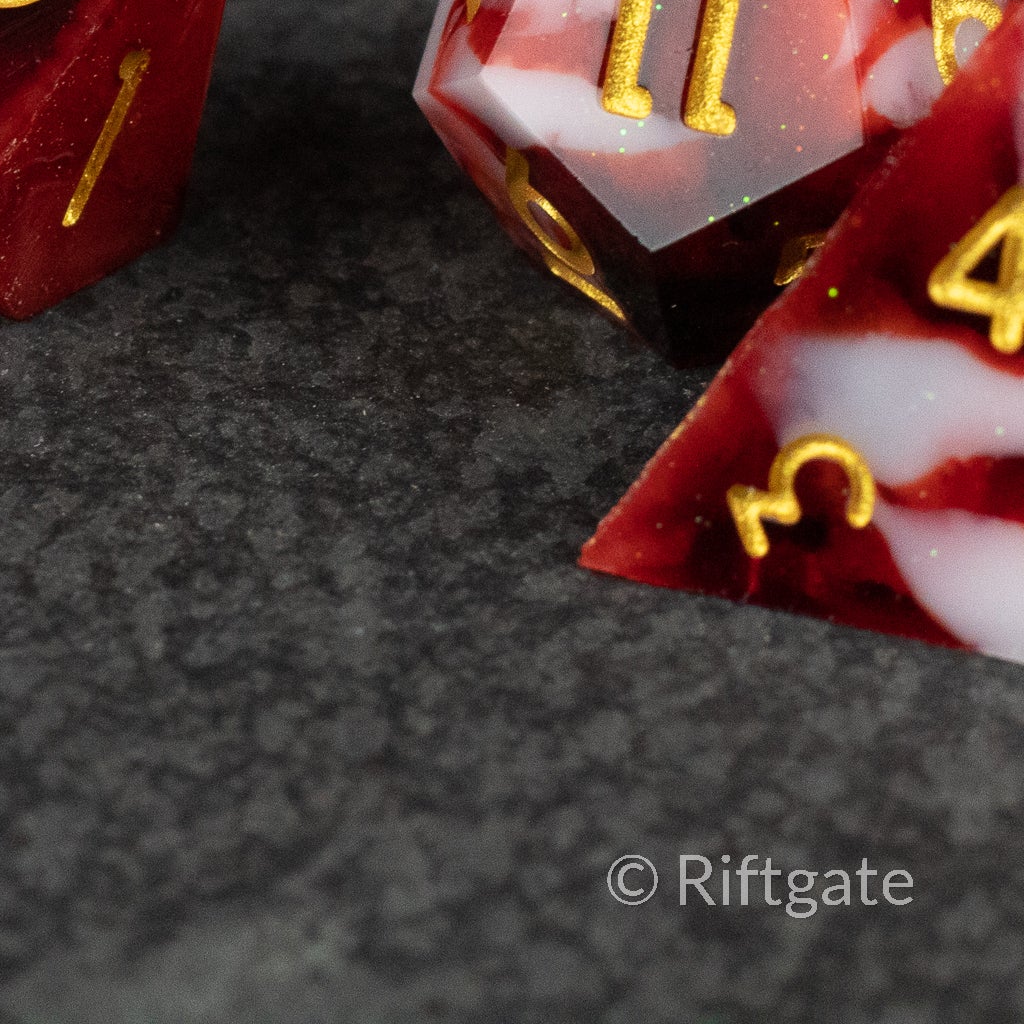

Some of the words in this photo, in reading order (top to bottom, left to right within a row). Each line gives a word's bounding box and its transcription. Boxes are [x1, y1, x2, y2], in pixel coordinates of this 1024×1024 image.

[62, 49, 150, 228] 1
[928, 184, 1024, 353] 4
[725, 434, 874, 557] 3
